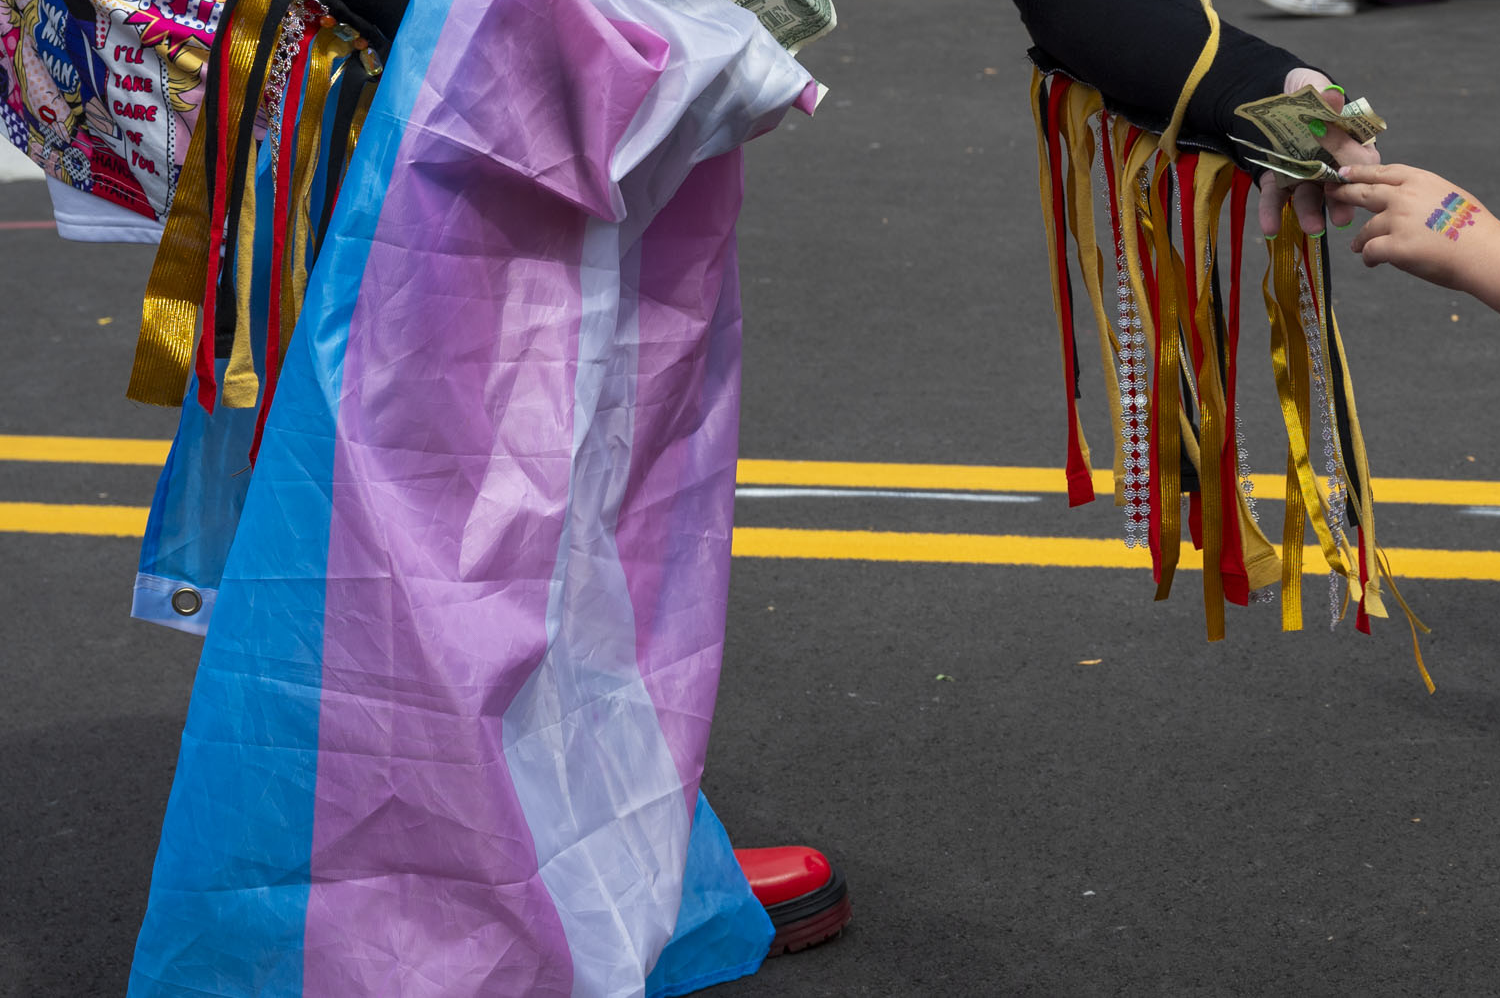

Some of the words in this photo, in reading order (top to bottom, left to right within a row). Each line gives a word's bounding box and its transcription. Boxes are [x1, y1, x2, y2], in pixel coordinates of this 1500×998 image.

[113, 44, 145, 65] I'LL
[112, 73, 154, 93] TAKE
[112, 100, 158, 122] CARE
[126, 129, 144, 147] OF
[131, 149, 161, 177] YOU.
